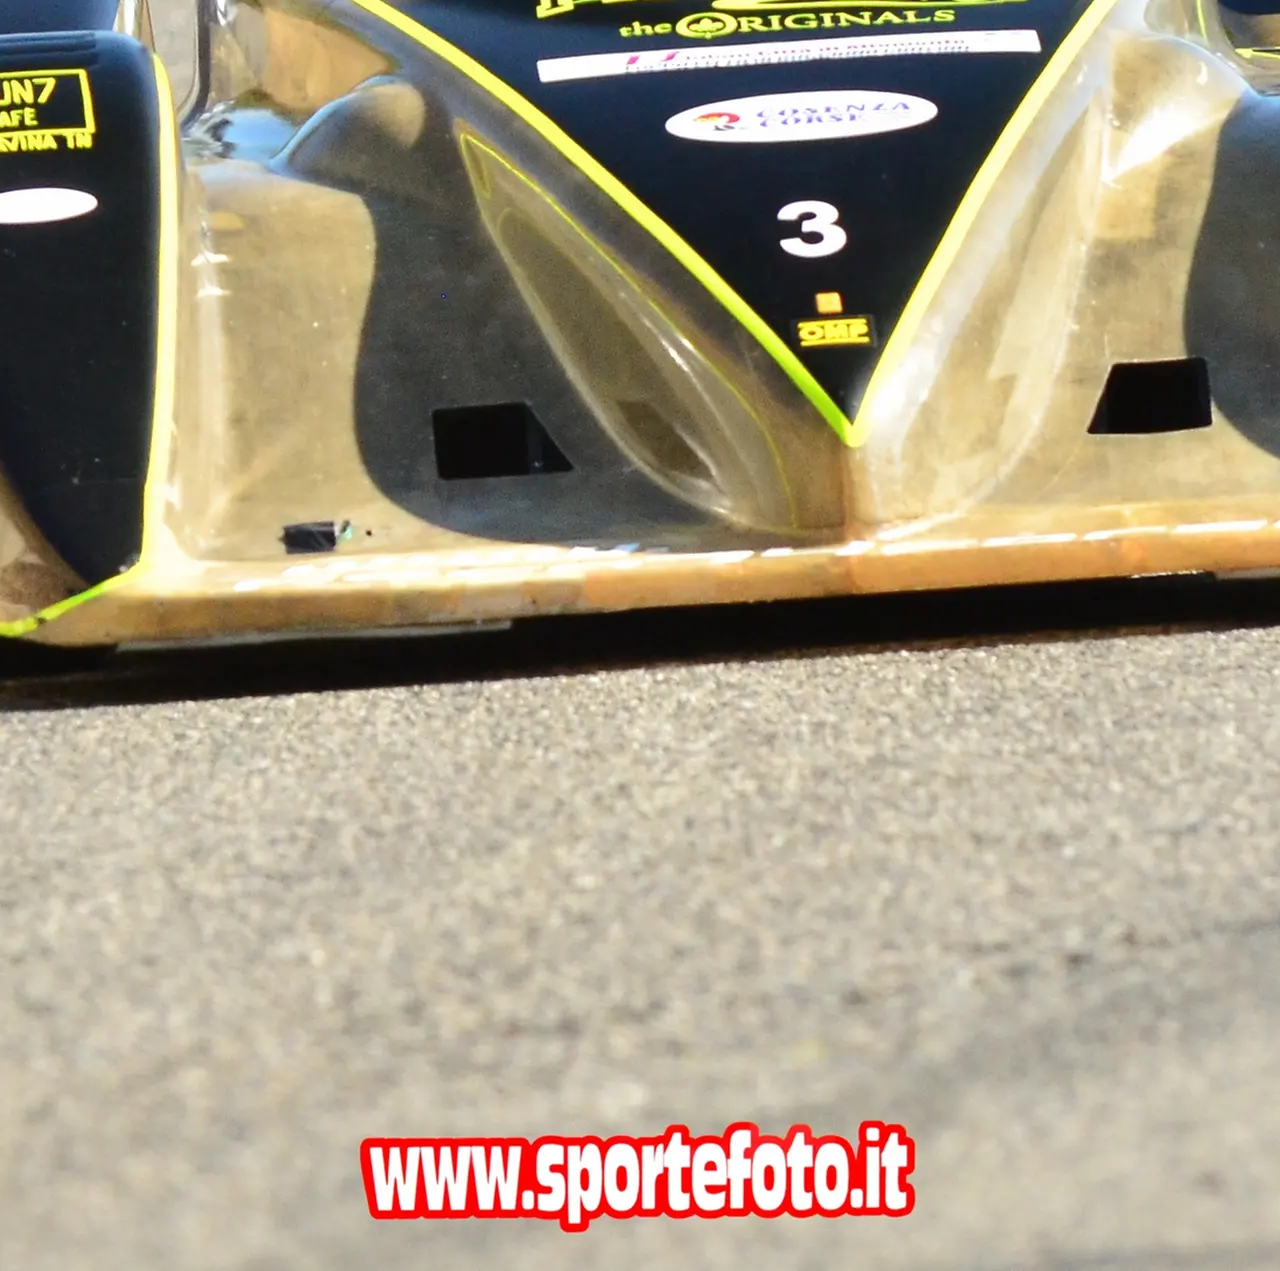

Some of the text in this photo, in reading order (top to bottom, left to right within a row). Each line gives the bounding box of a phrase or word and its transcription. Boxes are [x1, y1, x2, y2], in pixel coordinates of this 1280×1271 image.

[619, 20, 673, 37] the
[776, 200, 848, 258] 3
[798, 321, 870, 345] OMP
